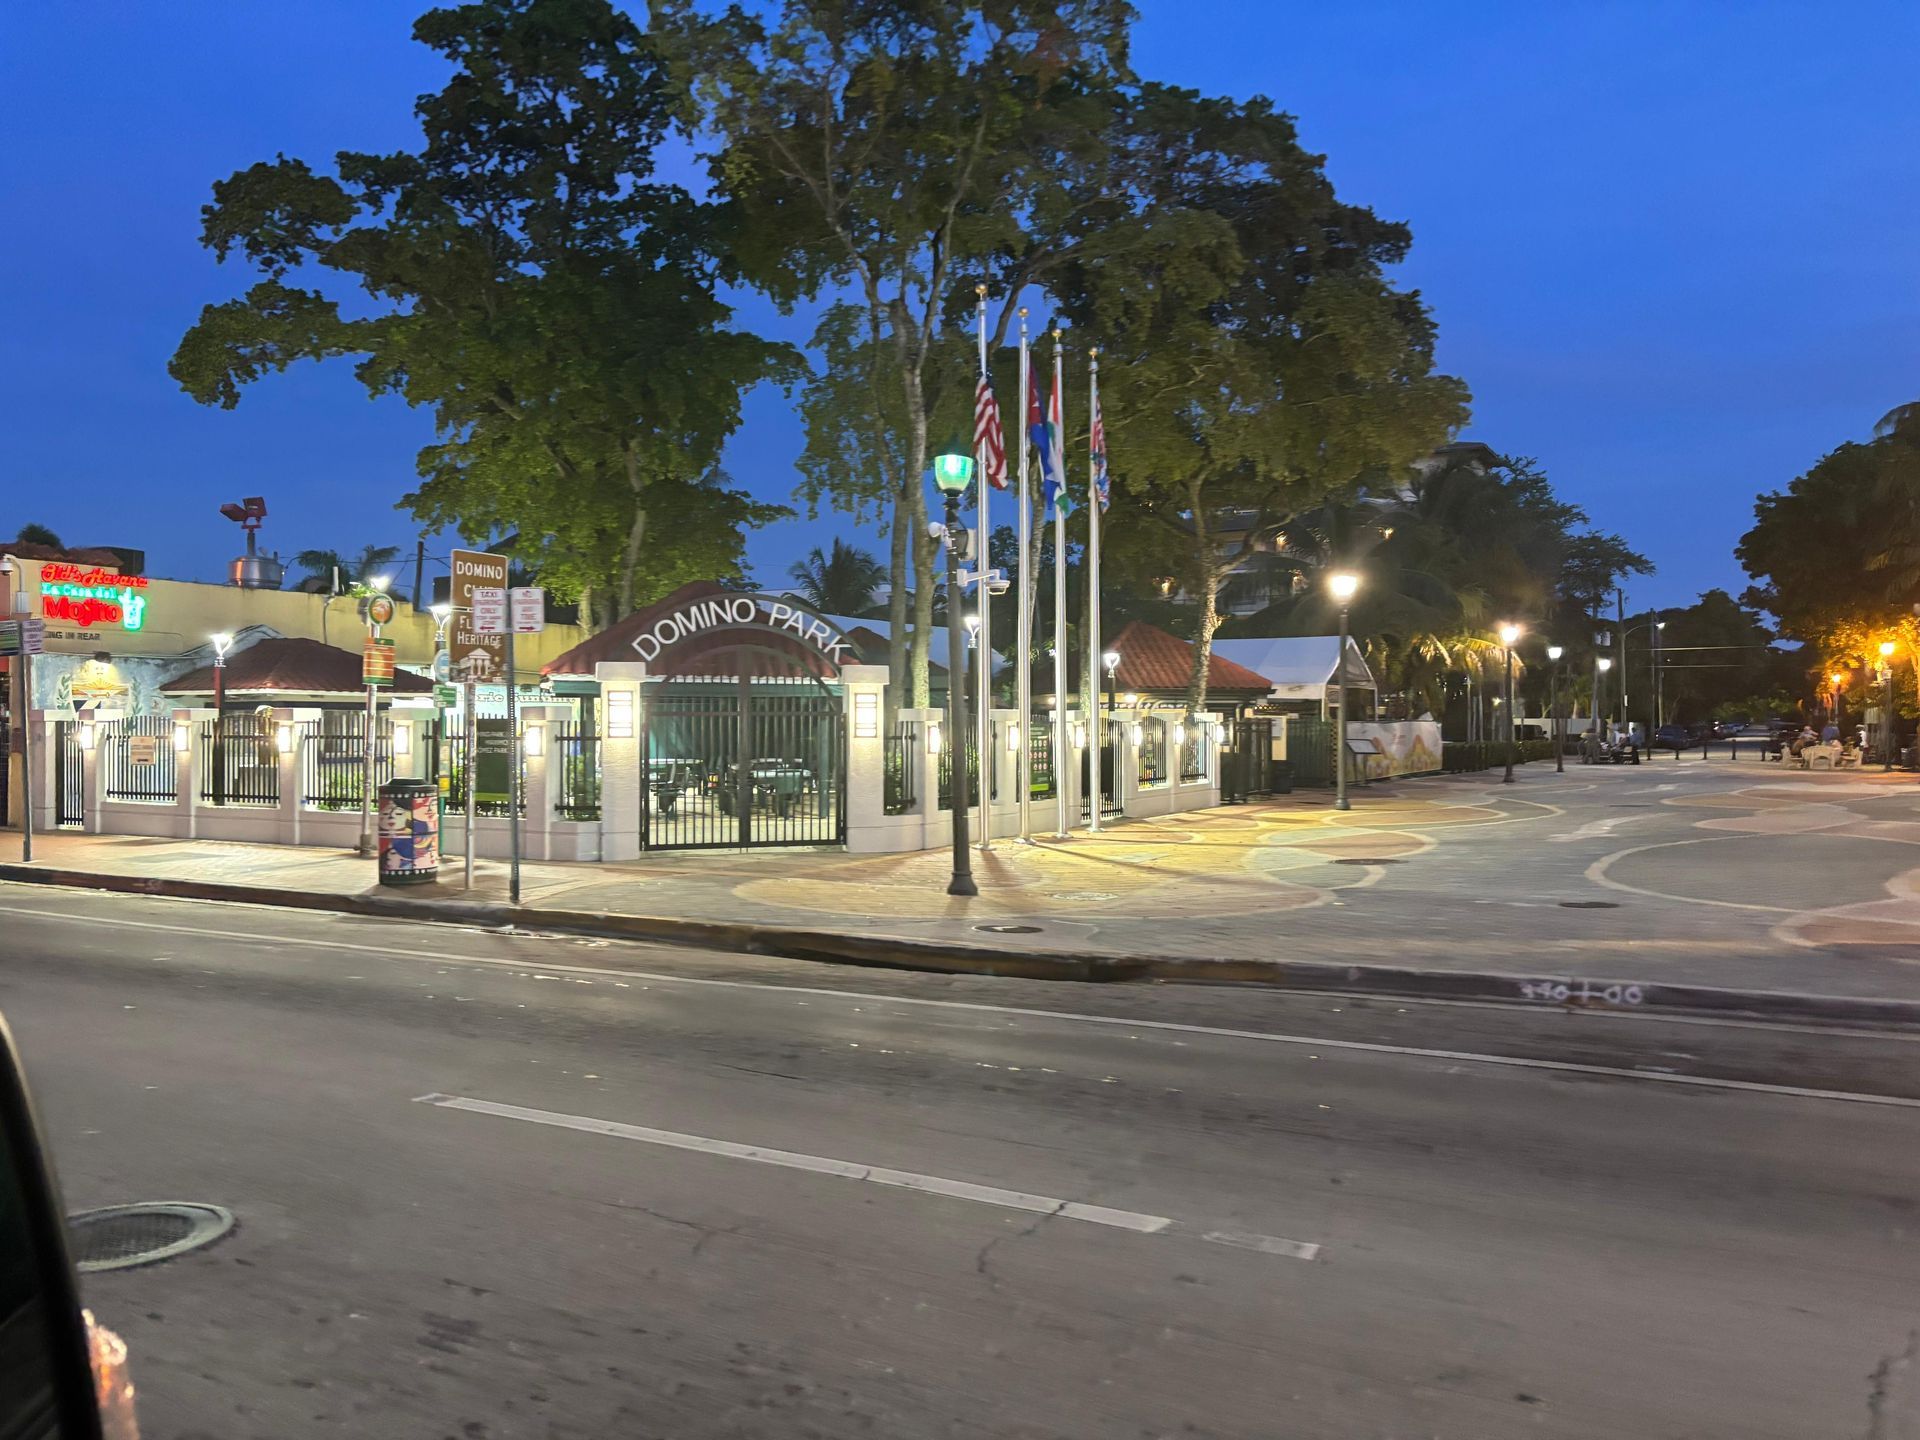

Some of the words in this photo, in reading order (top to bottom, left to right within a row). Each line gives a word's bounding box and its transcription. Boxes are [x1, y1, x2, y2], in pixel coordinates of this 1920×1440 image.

[81, 568, 148, 587] Havana
[456, 561, 503, 579] DOMINO
[41, 582, 59, 595] La
[63, 584, 93, 597] Casa
[95, 586, 118, 599] del
[77, 632, 101, 640] REAR
[457, 631, 503, 646] HERITAGE
[631, 598, 756, 662] DOMINO
[768, 602, 853, 664] PARK
